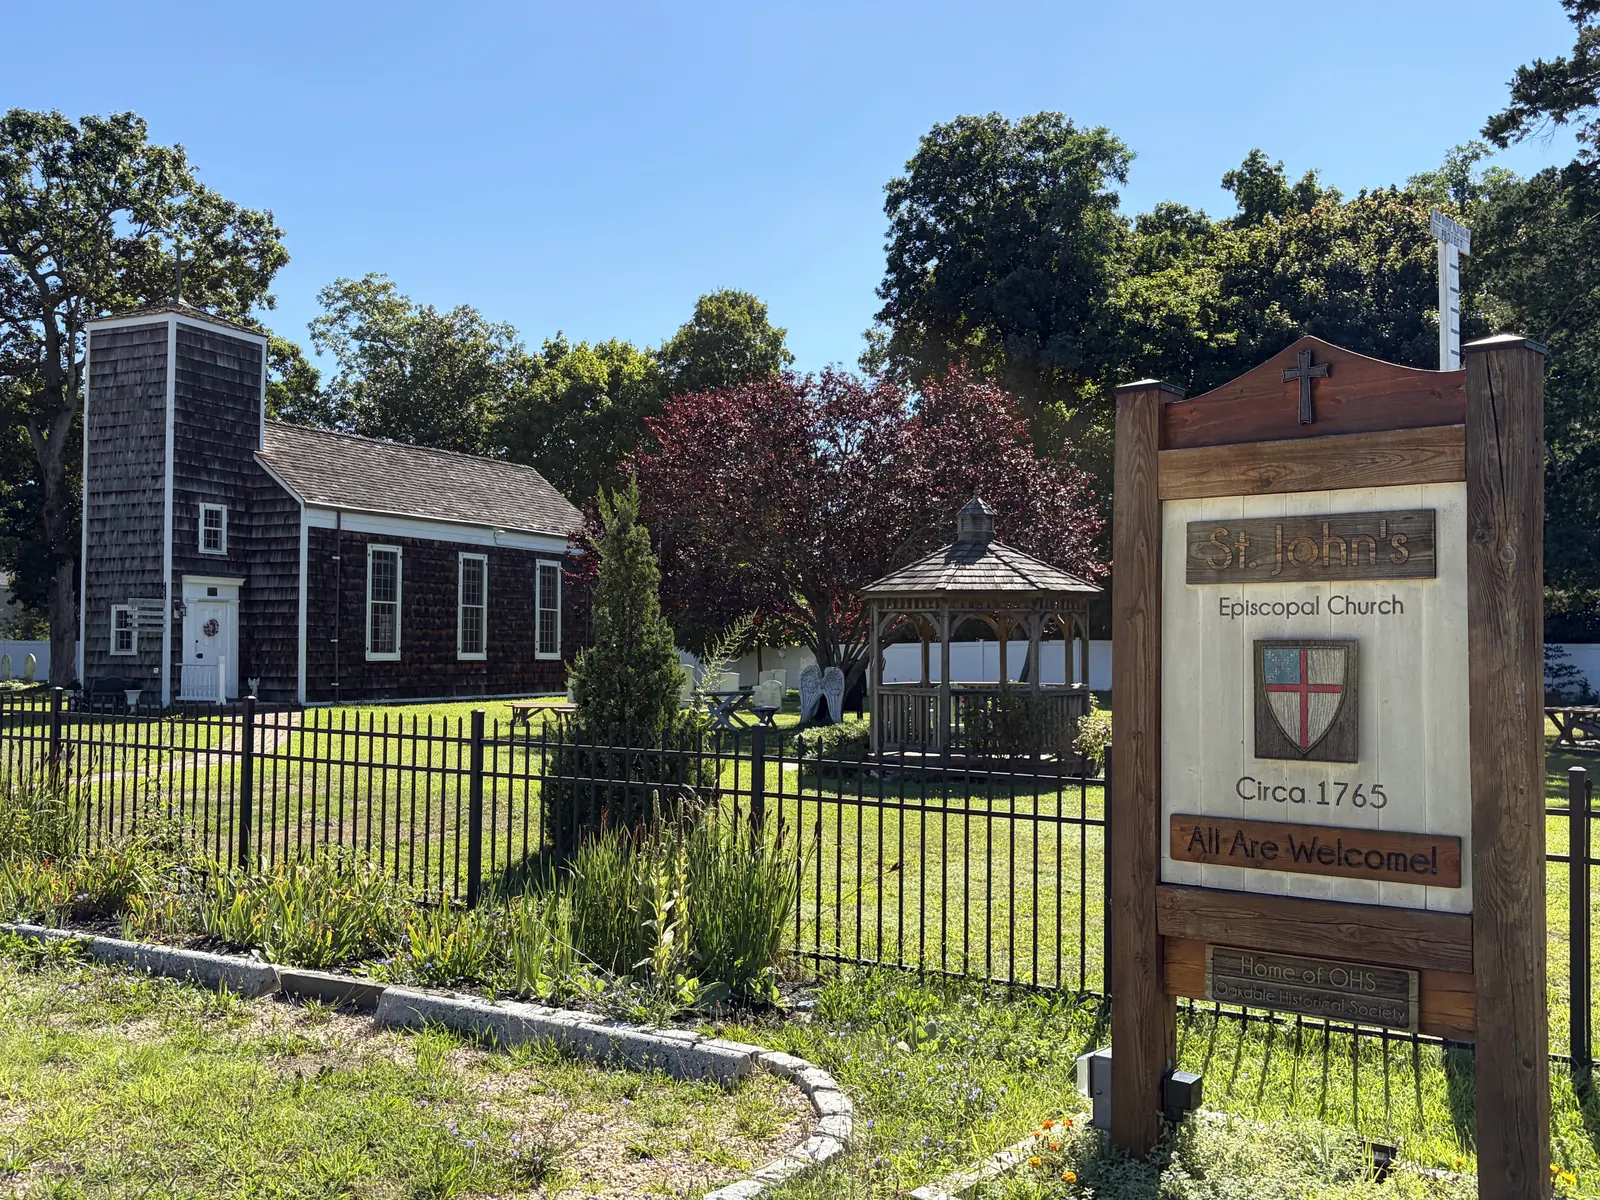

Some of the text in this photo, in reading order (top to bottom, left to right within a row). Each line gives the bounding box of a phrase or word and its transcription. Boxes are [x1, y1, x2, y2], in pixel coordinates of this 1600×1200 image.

[1206, 519, 1409, 576] St. John's
[1219, 594, 1404, 619] Episcopal Church
[1316, 781, 1388, 809] 1765
[1187, 825, 1438, 875] All Are Welcome!
[1240, 955, 1377, 993] Home of OHS
[1215, 981, 1406, 1024] Oakdale Historical Society
